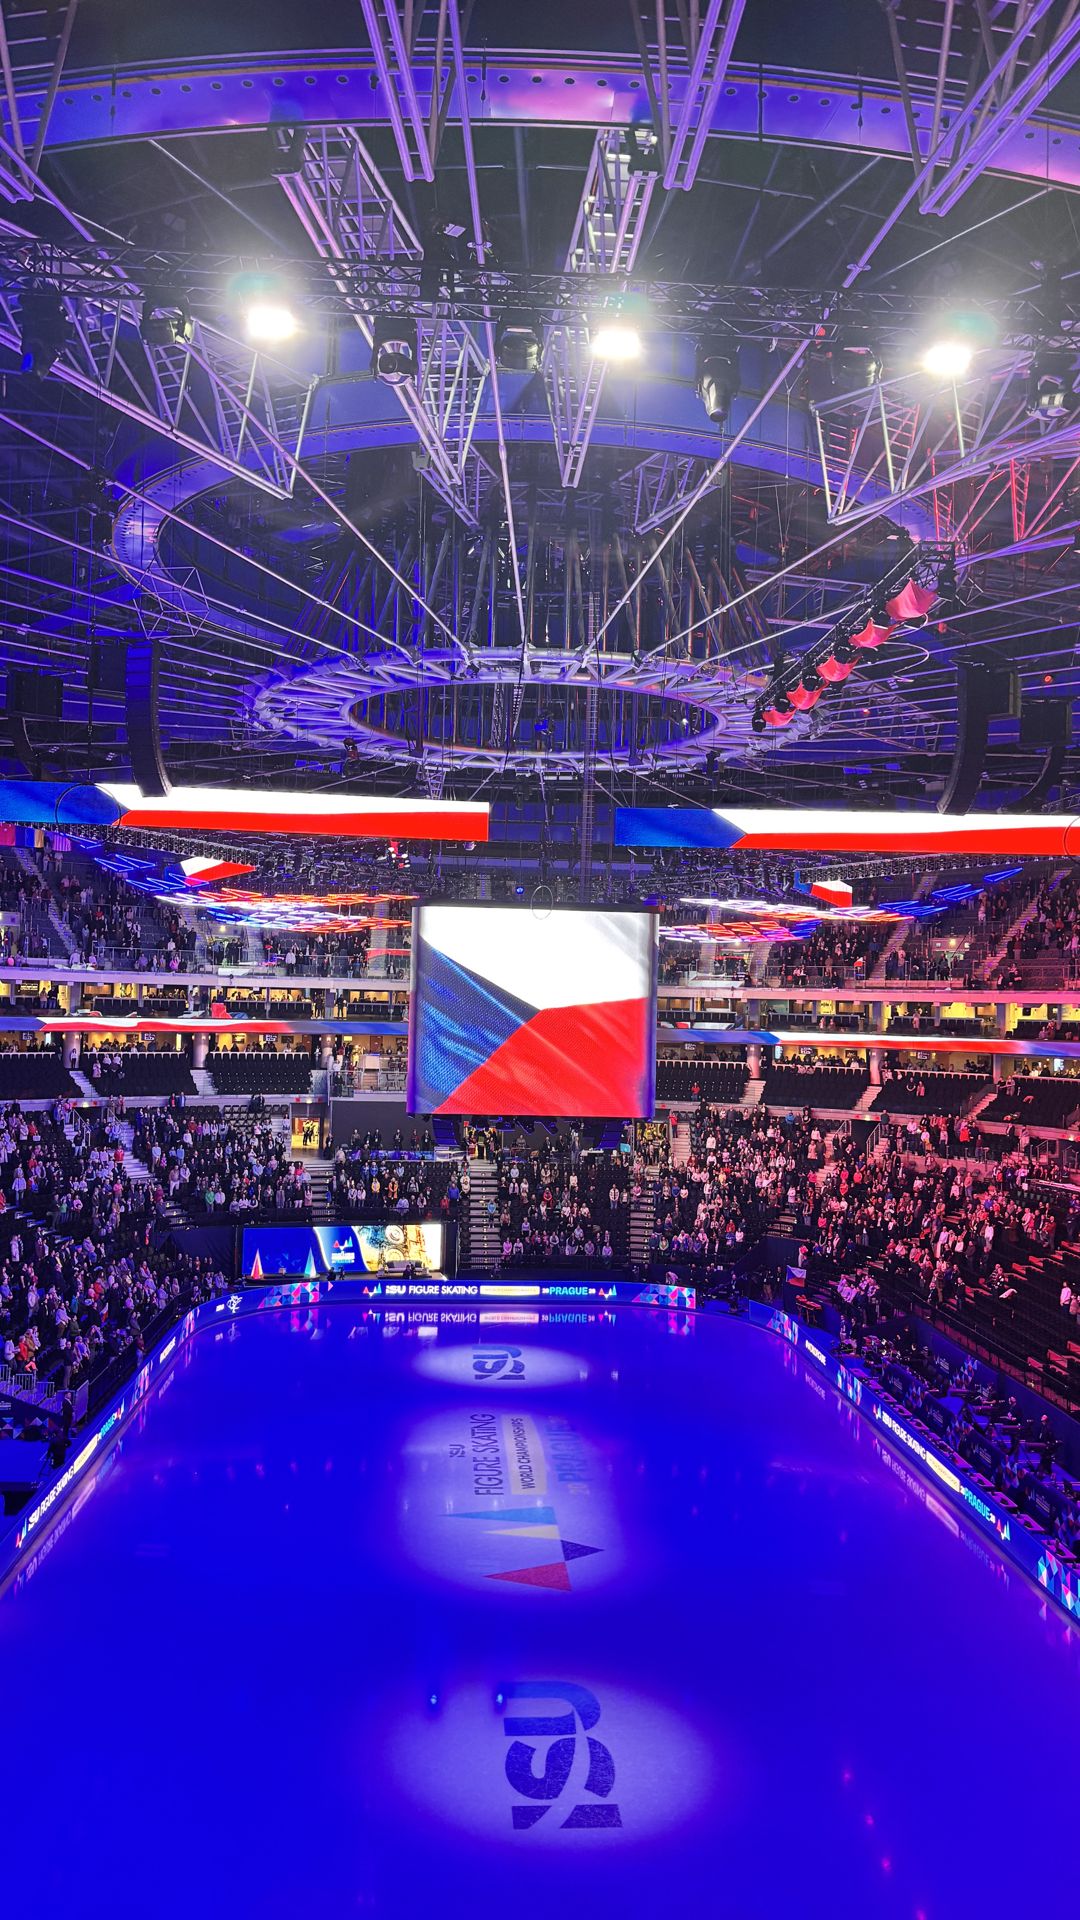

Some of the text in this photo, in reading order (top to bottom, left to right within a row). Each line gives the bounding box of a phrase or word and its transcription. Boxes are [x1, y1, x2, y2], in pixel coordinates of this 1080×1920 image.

[385, 1285, 406, 1295] ISU
[408, 1285, 440, 1295] FIGURE
[441, 1285, 478, 1295] SKATING
[549, 1286, 588, 1296] PRAGUE
[472, 1345, 526, 1381] ISU
[470, 1413, 504, 1495] FIGURE SKATING
[511, 1417, 536, 1489] WORLD CHAMPIONSHIPS
[963, 1487, 990, 1521] PRAGUE
[499, 1680, 623, 1829] ISU
